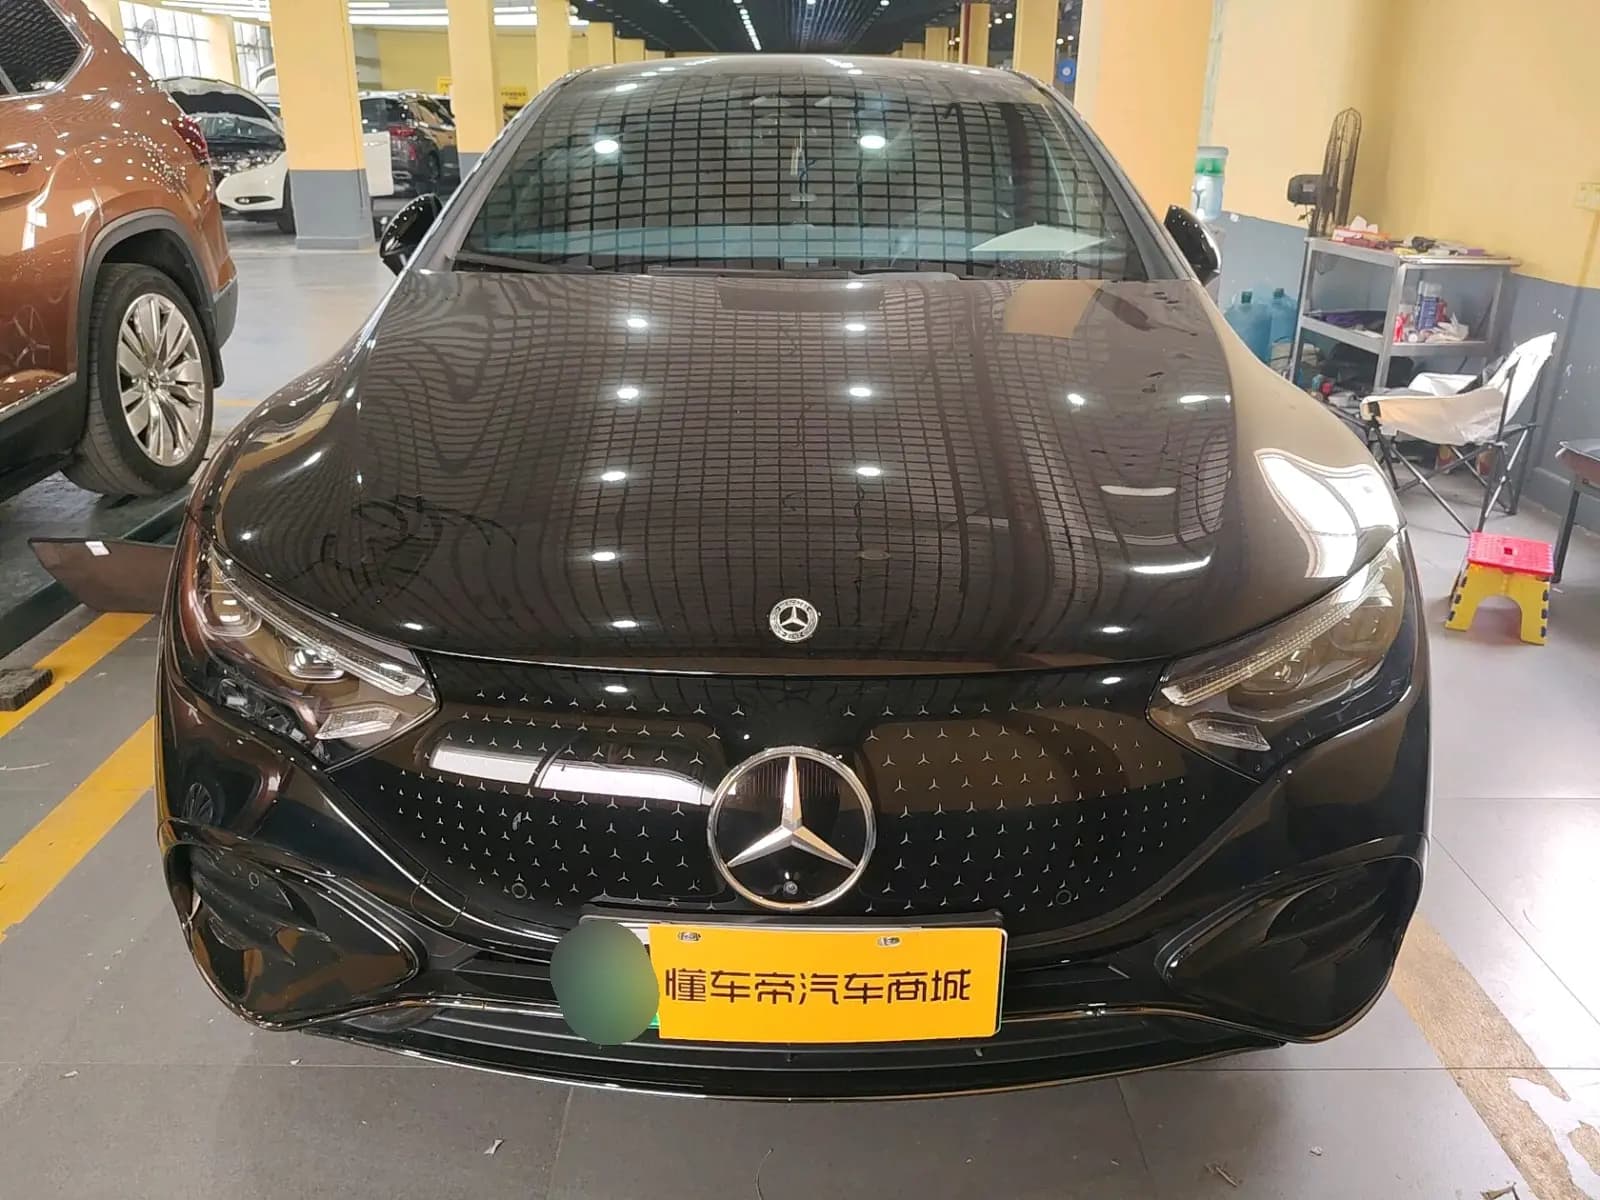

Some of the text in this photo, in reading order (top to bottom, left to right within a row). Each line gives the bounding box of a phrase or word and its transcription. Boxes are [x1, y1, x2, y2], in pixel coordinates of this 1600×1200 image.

[665, 967, 971, 1005] 懂车帝汽车商城
